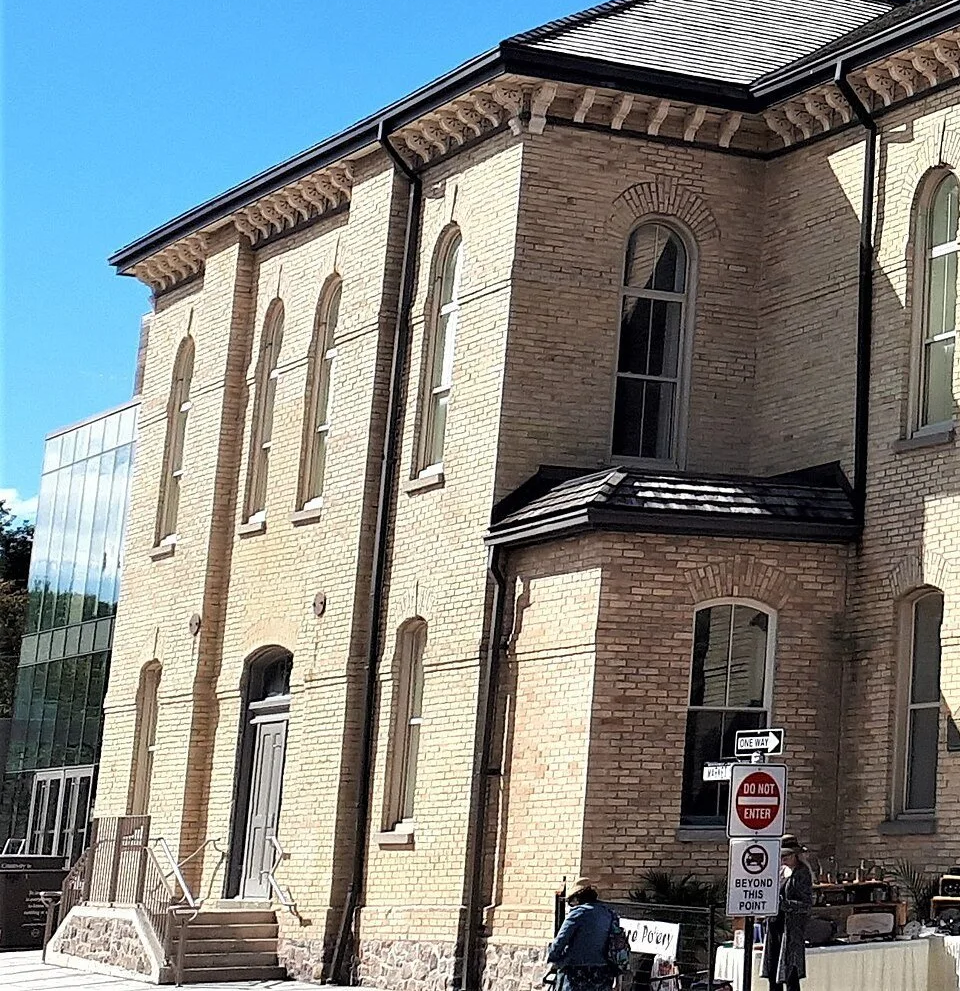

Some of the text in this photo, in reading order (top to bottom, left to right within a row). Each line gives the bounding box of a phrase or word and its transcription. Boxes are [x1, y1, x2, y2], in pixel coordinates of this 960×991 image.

[739, 738, 769, 748] ONE WAY
[743, 783, 776, 794] DO NOT
[744, 808, 771, 819] ENTER
[735, 878, 773, 888] BEYOND
[743, 889, 764, 899] THIS
[739, 900, 767, 911] POINT
